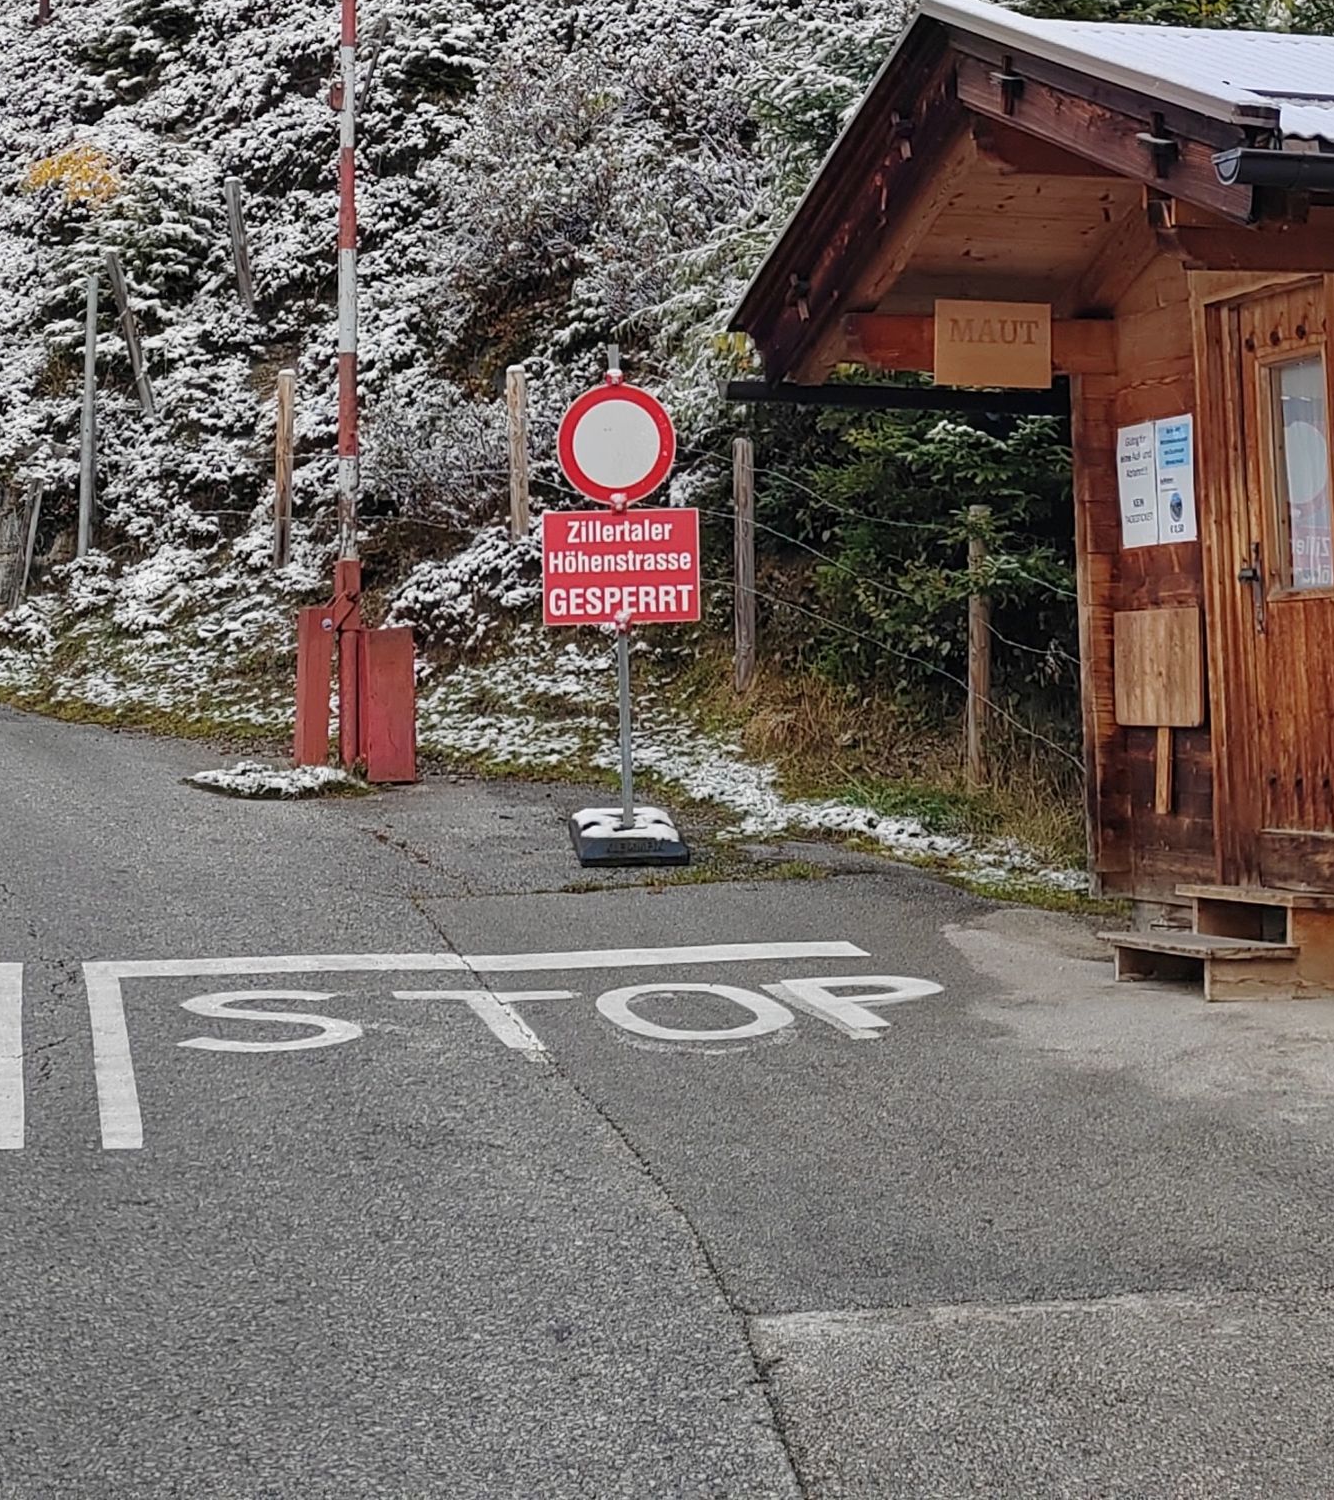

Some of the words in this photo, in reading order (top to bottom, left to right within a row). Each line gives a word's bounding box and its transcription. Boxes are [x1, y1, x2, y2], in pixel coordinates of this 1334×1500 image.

[949, 318, 1039, 345] MAUT
[567, 519, 673, 543] Zillertaler
[549, 550, 691, 574] Höhenstrasse
[549, 585, 693, 616] GESPERRT
[177, 975, 945, 1060] STOP
